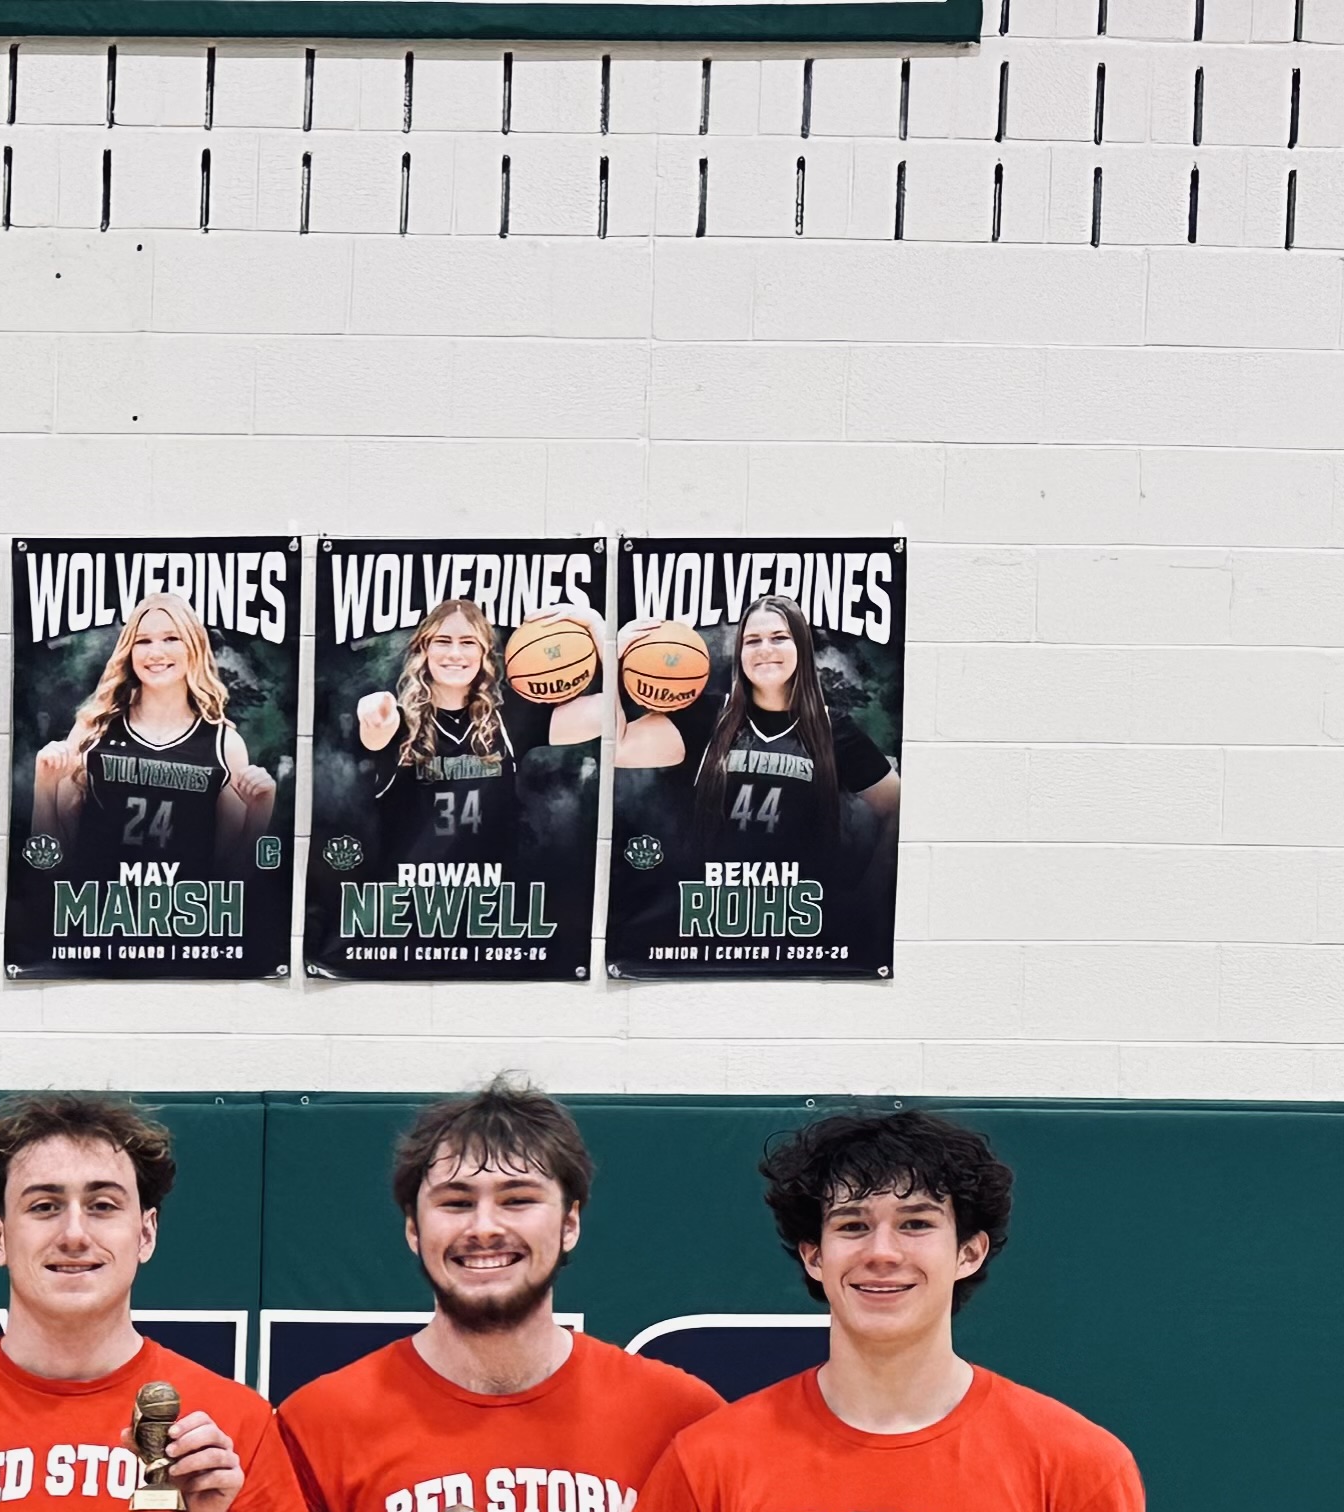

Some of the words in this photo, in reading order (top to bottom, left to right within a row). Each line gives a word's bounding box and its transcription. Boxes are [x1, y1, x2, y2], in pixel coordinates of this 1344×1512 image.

[26, 551, 287, 644] WOLVERINES
[332, 553, 591, 645] WOLVERINES
[527, 668, 590, 696] Wilson
[636, 678, 697, 704] Wilson
[122, 797, 174, 848] 24
[433, 790, 483, 836] 34
[729, 783, 783, 834] 44
[120, 862, 180, 887] MAY
[398, 863, 502, 887] ROWAN
[705, 862, 799, 887] BEKAH
[53, 880, 244, 937] MARSH
[340, 882, 558, 938] NEWELL
[679, 880, 823, 938] ROHS
[52, 945, 101, 960] JUNIOR
[118, 946, 165, 960] GUARD
[346, 946, 397, 960] SENIOR
[415, 946, 468, 960] CENTER
[649, 946, 698, 960] JUNIOR
[715, 946, 770, 960] CENTER
[787, 946, 849, 960] 2025-26
[45, 1444, 149, 1500] STO
